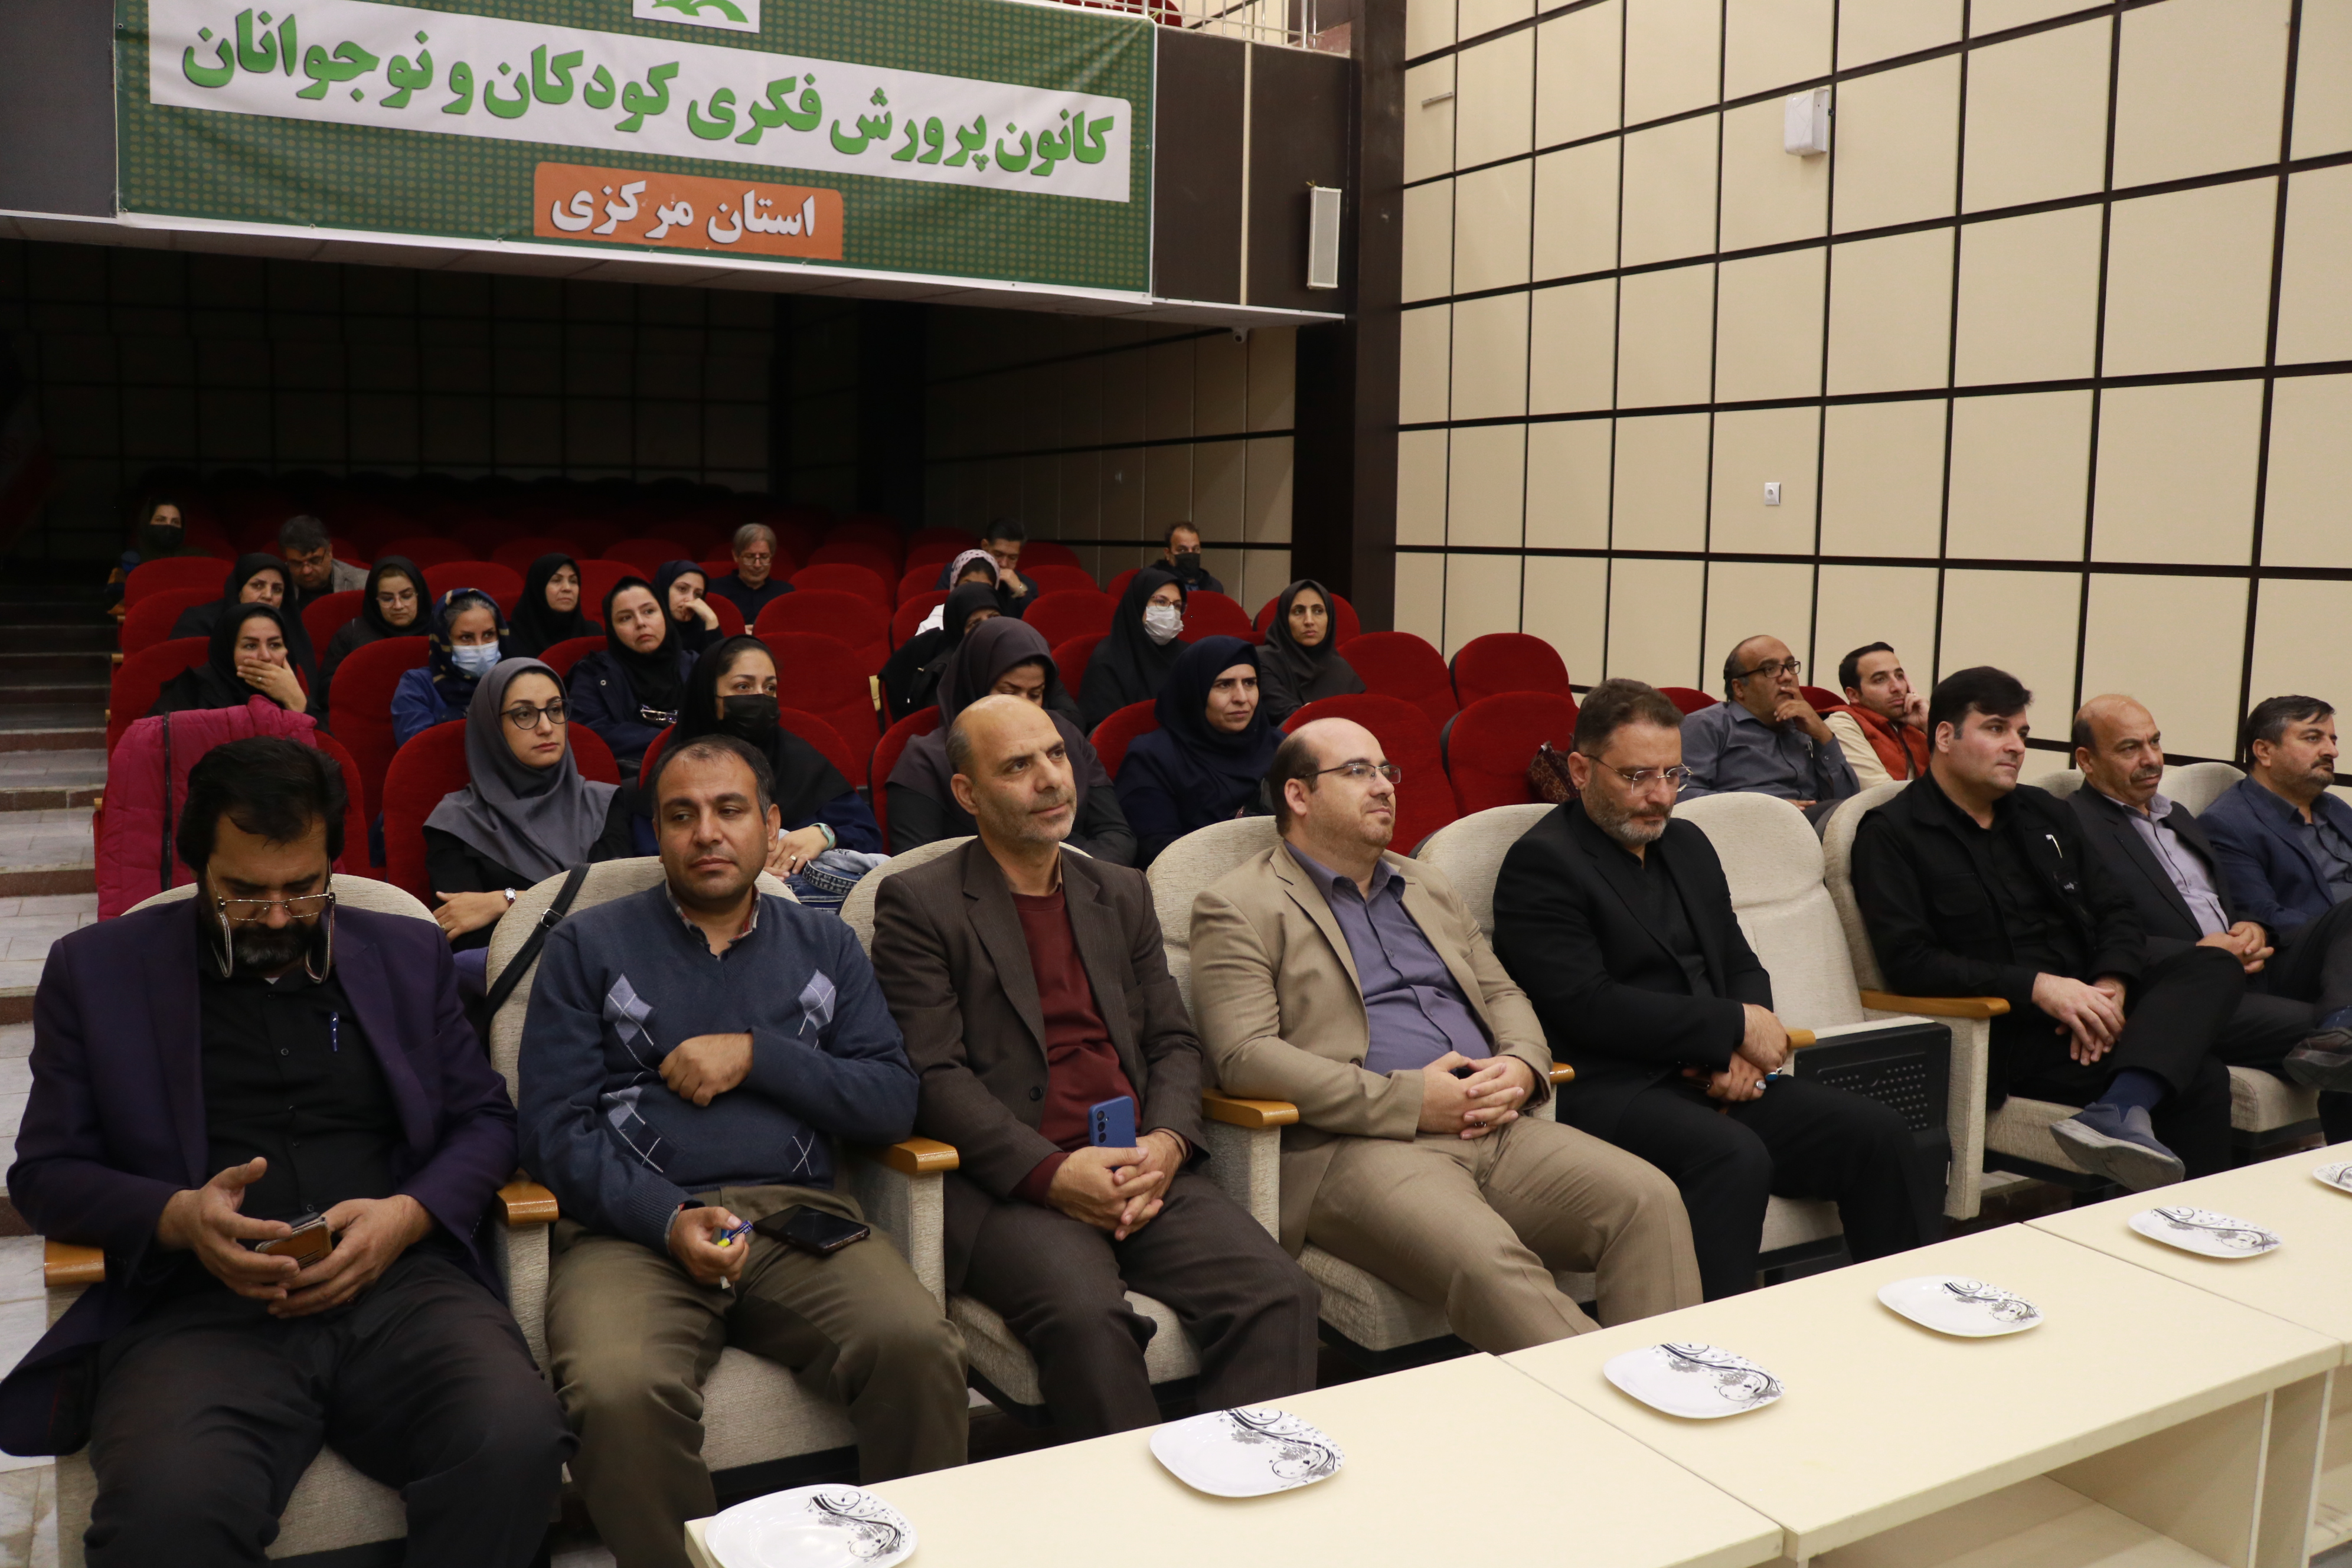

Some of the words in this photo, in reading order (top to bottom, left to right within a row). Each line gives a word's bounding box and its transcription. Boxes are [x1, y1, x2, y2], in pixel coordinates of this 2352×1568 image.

[484, 44, 680, 132] کودکان
[687, 73, 823, 145] فکری
[831, 87, 989, 172] پرورش
[995, 109, 1115, 177] کانون
[551, 179, 694, 240] مرکزی
[708, 189, 815, 244] استان
